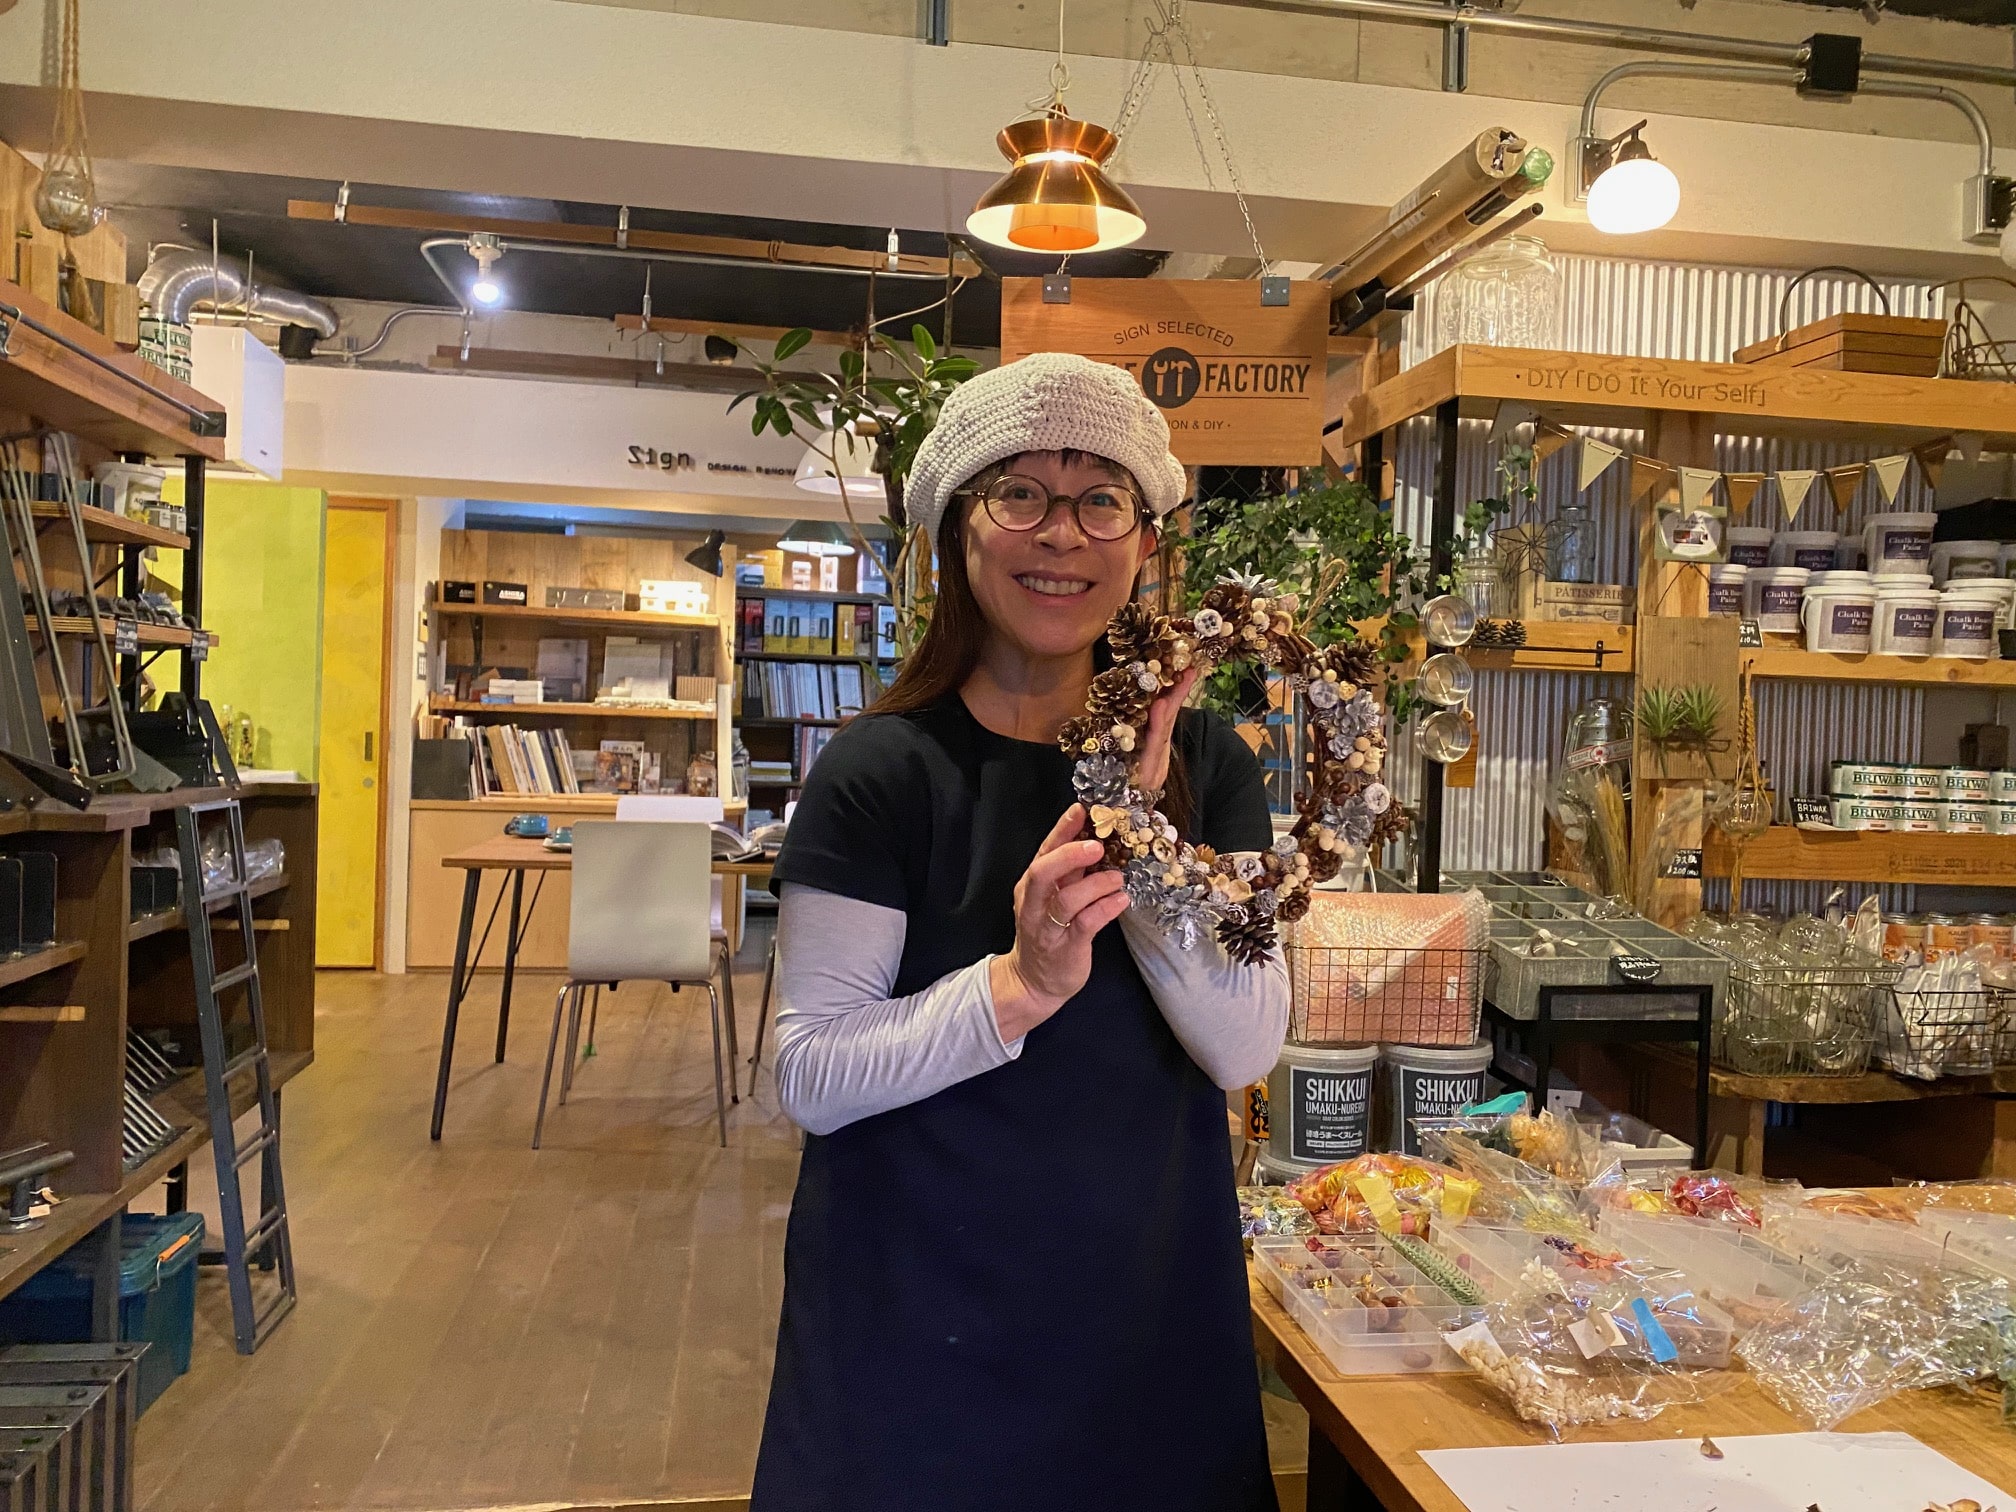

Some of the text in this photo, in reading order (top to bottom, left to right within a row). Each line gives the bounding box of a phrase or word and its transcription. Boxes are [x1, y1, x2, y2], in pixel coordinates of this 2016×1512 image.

[1113, 321, 1235, 348] SIGN SELECTED
[1205, 363, 1311, 394] FACTORY
[1527, 367, 1568, 389] DIY
[1630, 376, 1648, 396] It
[1656, 377, 1704, 401] Your
[1192, 420, 1200, 430] &
[1203, 420, 1224, 430] DIY
[1837, 610, 1860, 619] Chalk
[1899, 613, 1923, 622] Chalk
[1947, 615, 1972, 624] Chalk
[1961, 623, 1982, 631] Paint
[1306, 1077, 1367, 1102] SHIKKUI
[1415, 1078, 1479, 1102] SHIKKUI
[1305, 1101, 1365, 1115] UMAKU-NURERU
